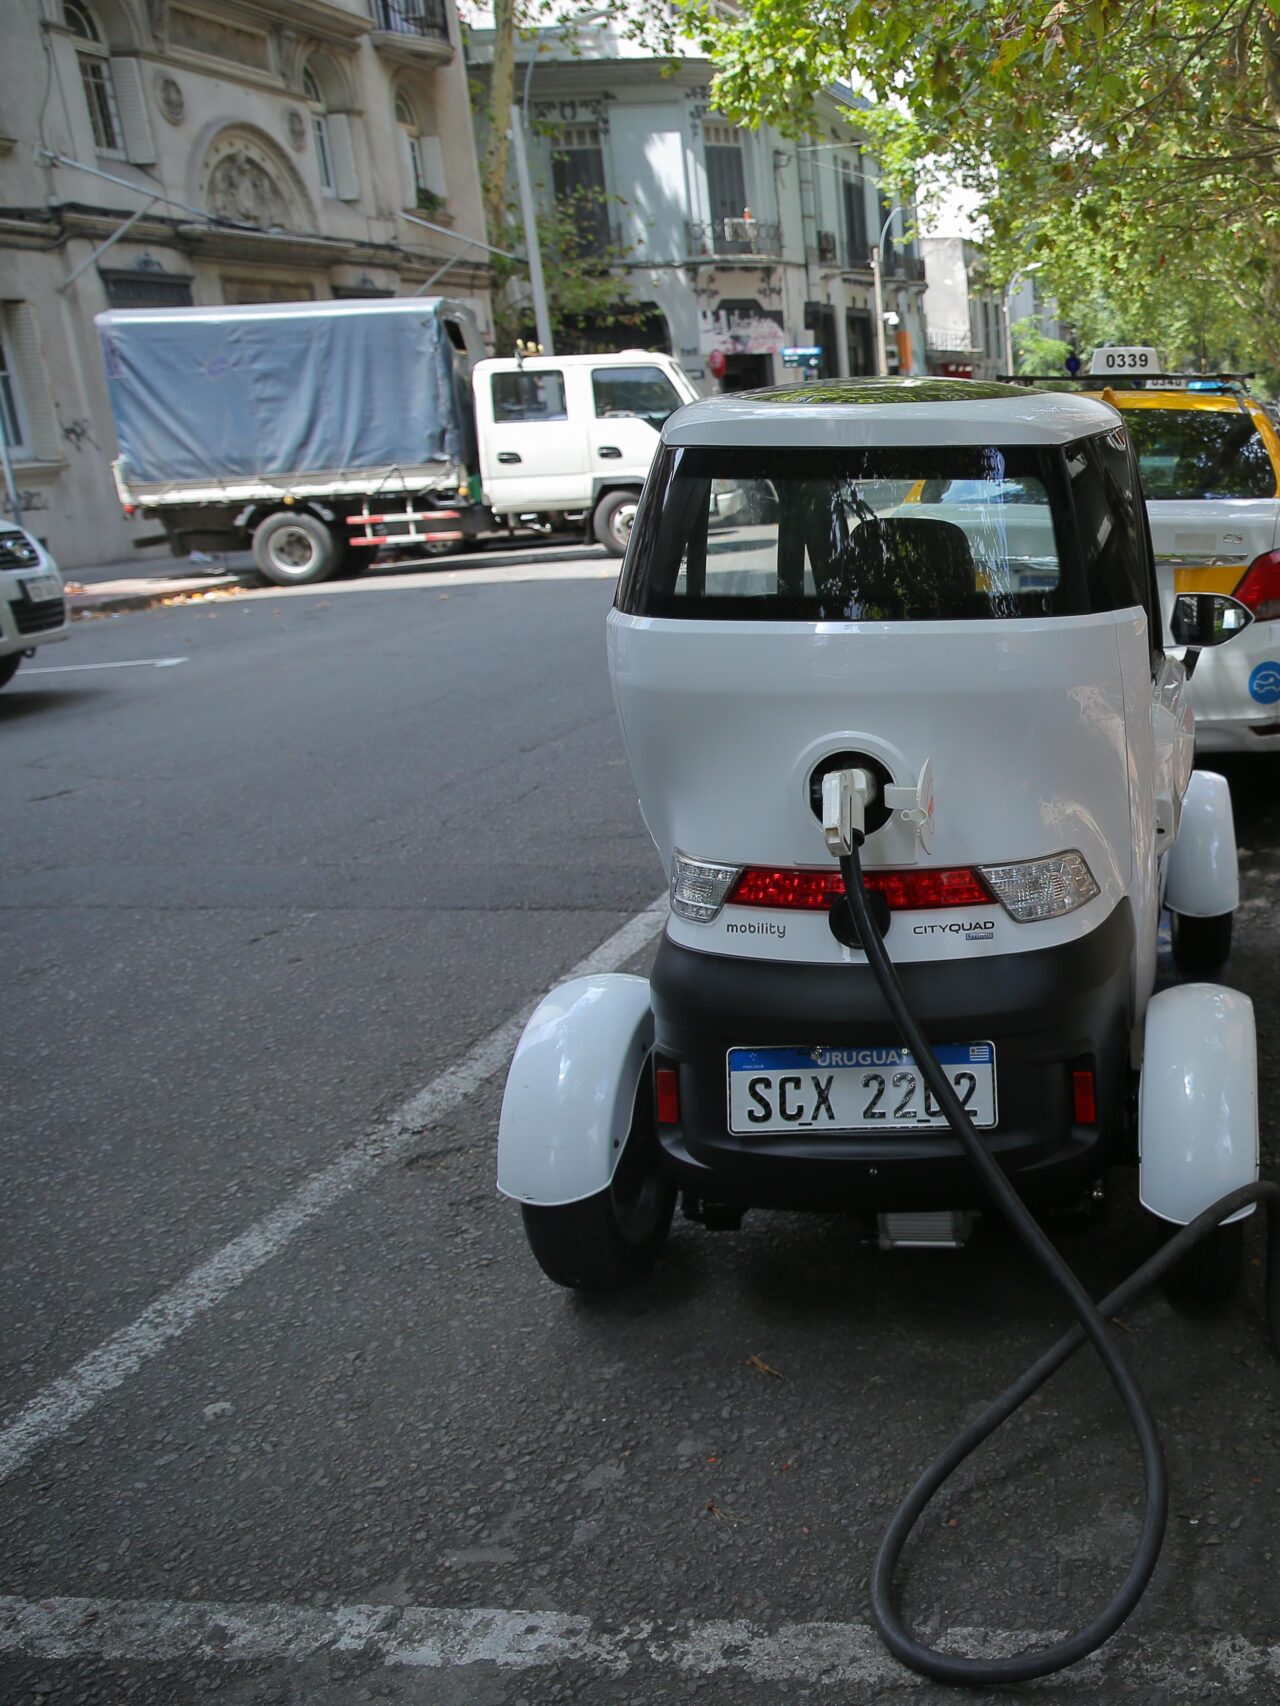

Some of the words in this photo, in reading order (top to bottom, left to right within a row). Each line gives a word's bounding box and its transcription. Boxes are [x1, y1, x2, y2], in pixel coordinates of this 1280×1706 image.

[1106, 353, 1149, 368] 0339
[726, 922, 786, 939] mobility
[913, 920, 995, 935] CITYQUAD
[747, 1074, 835, 1123] SCX
